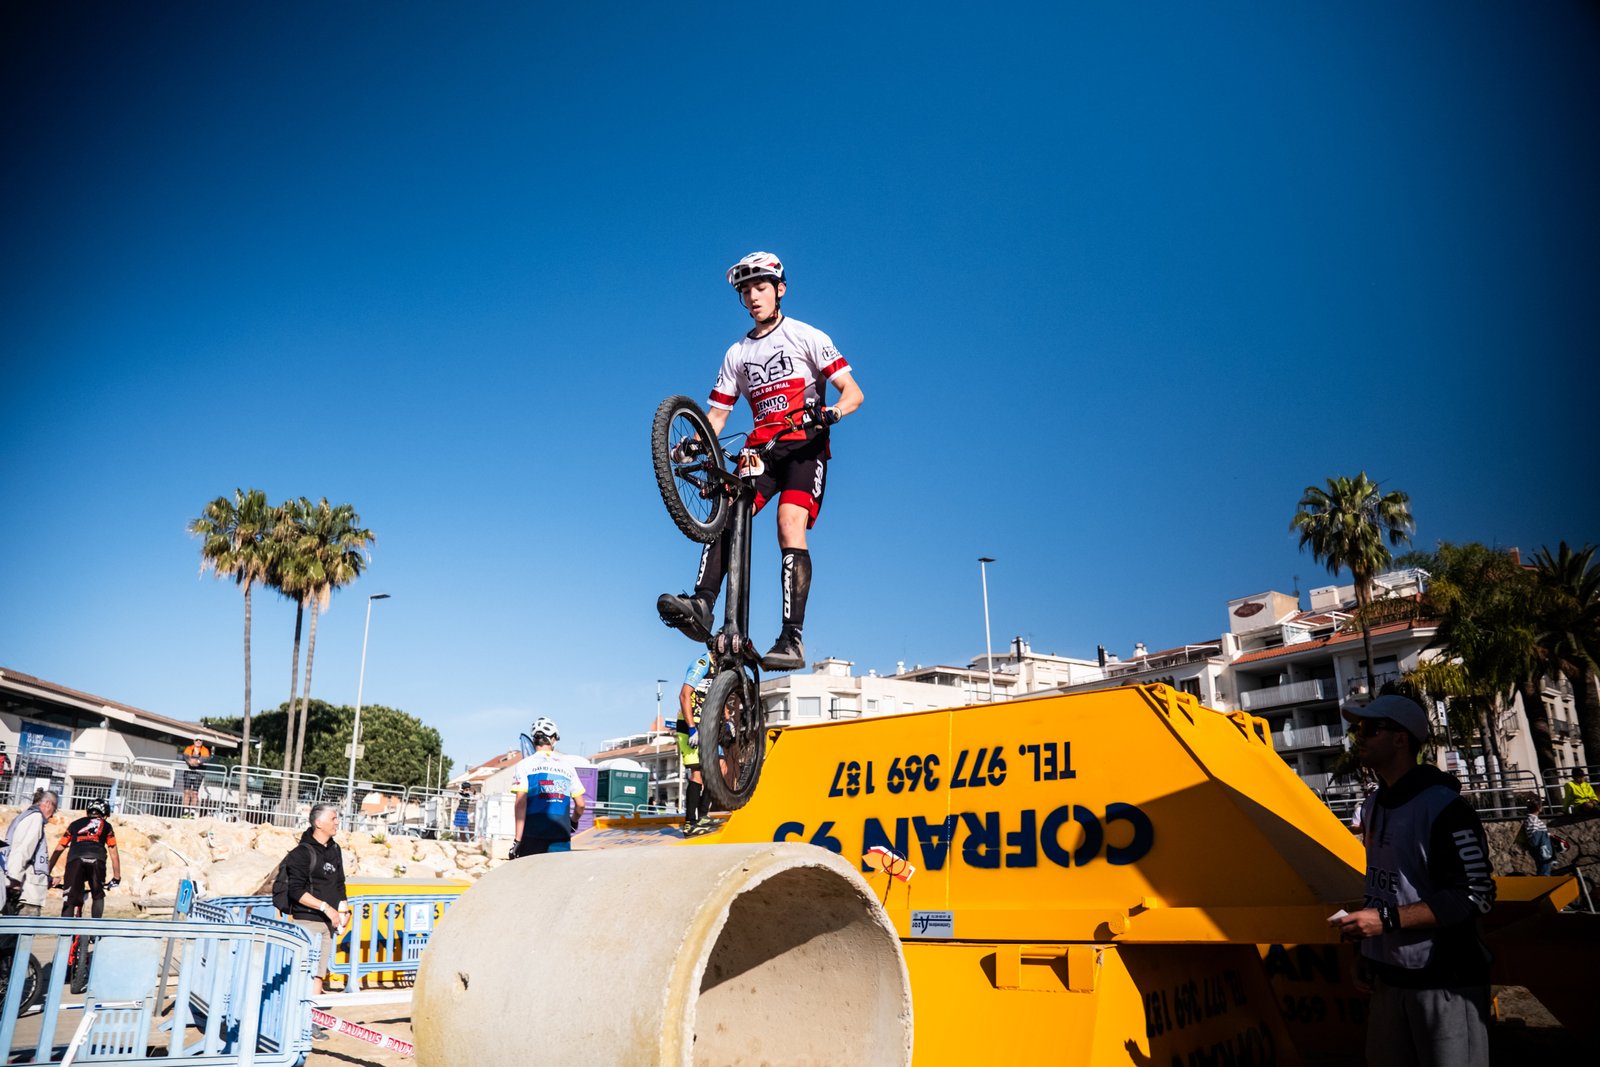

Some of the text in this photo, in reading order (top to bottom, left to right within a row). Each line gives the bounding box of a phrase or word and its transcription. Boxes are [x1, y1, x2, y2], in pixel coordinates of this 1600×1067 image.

[773, 382, 790, 391] TRIAL
[741, 455, 757, 468] 20
[828, 741, 1077, 798] TEL. 977 369 187
[861, 801, 1155, 873] COFRAN
[182, 887, 190, 905] 1
[340, 1020, 383, 1045] BAUHAUS
